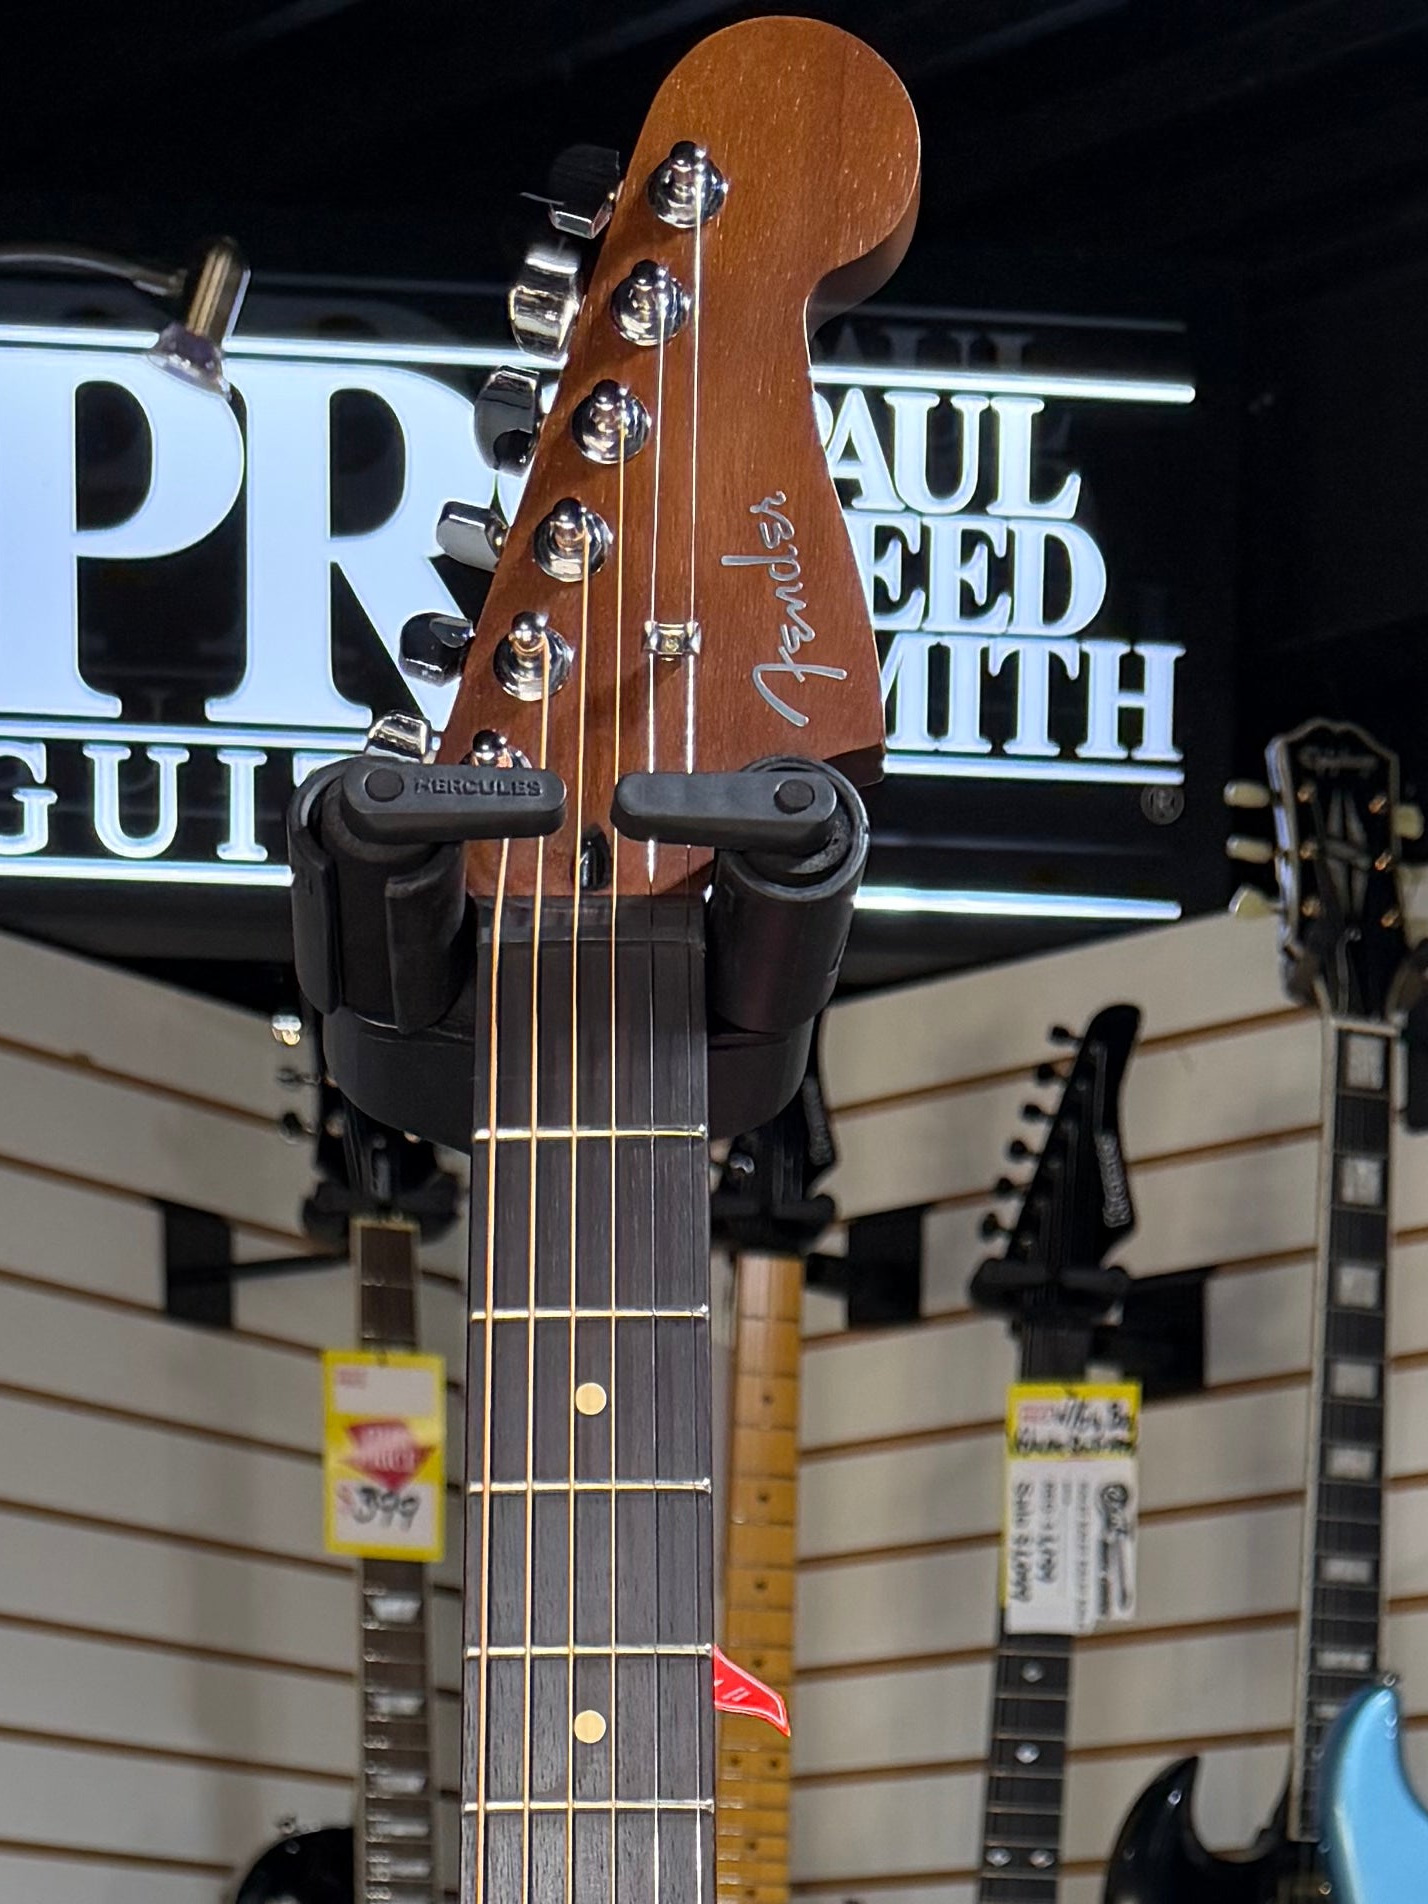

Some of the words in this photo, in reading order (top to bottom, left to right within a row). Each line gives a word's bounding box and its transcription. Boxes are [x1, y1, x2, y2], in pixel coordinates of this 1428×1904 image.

[720, 489, 848, 728] Fender
[844, 510, 1107, 637] EED
[414, 777, 542, 797] HERCULES
